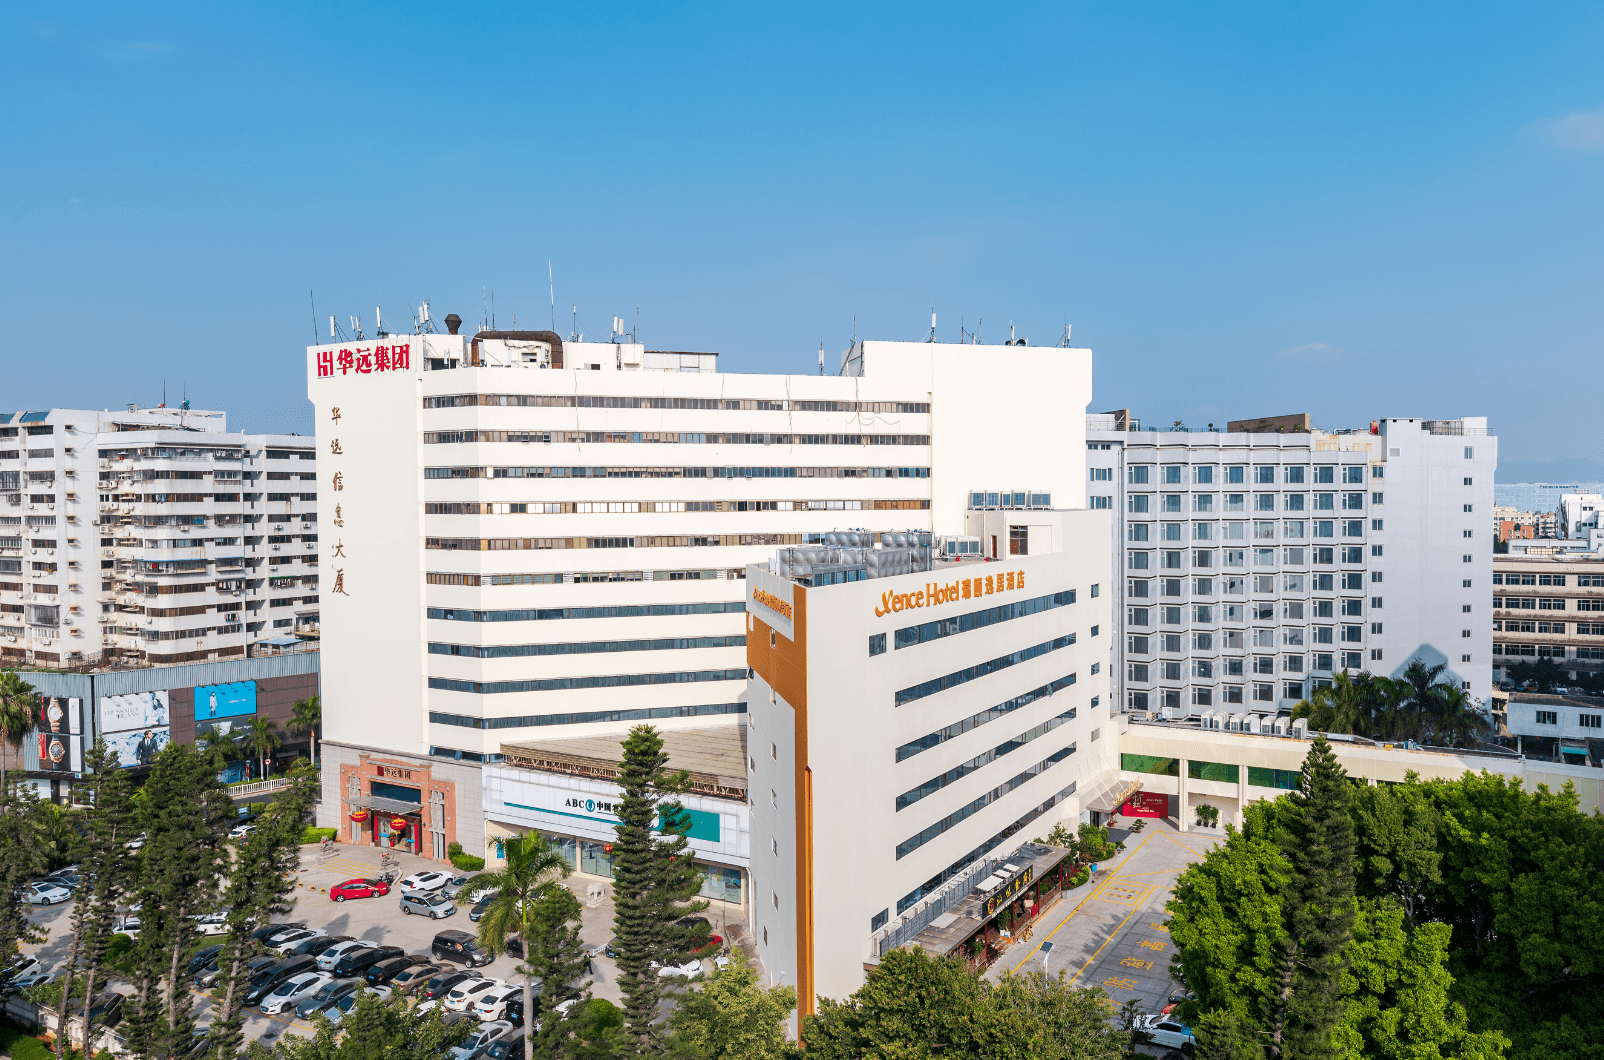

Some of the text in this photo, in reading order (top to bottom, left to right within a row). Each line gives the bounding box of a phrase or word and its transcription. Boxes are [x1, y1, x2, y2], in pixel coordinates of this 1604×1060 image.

[336, 343, 410, 375] 华远集团
[874, 580, 959, 617] Xence Hotel
[565, 798, 585, 808] ABC
